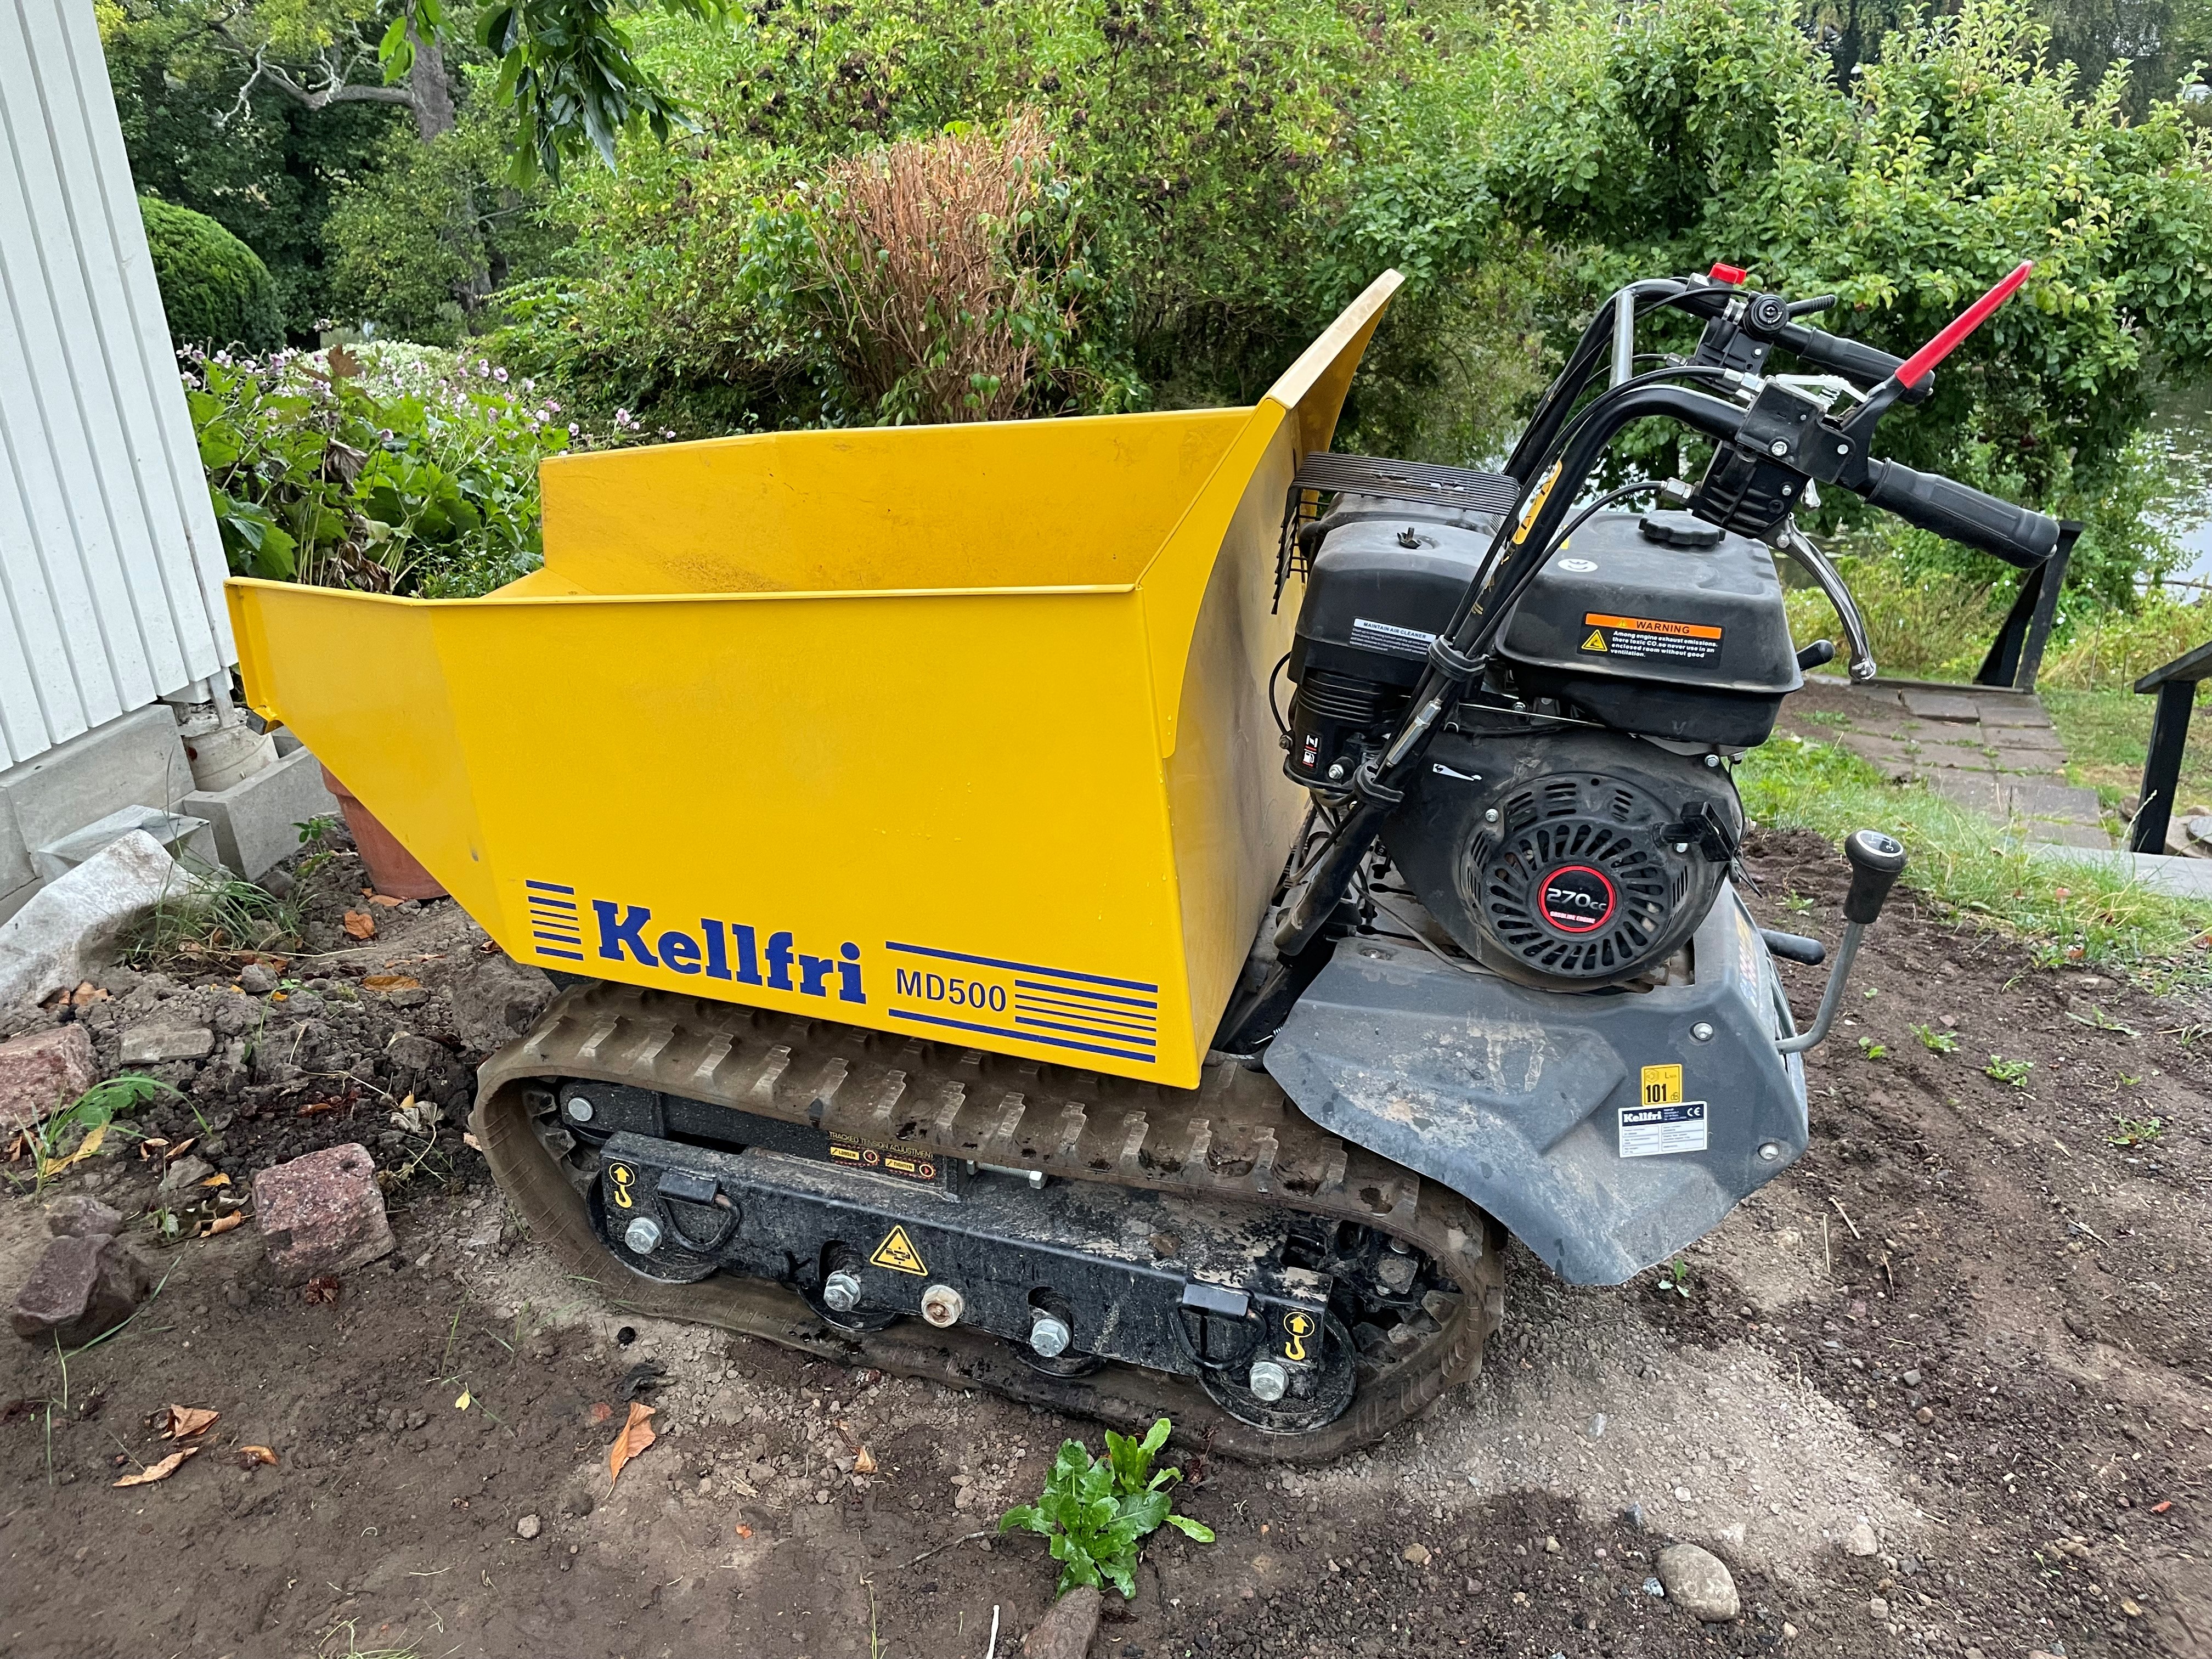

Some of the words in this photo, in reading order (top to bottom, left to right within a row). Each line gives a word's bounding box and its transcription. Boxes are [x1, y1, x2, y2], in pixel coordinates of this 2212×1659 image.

[1363, 622, 1389, 631] MAINTAIN
[1400, 630, 1426, 639] CLEANER
[1613, 630, 1636, 639] Among
[1636, 620, 1690, 634] WARNING
[1610, 649, 1646, 657] ventilation.
[1547, 888, 1607, 911] 270cc
[592, 900, 867, 1005] Kellfri
[896, 968, 1007, 1012] MD500
[1646, 1084, 1667, 1103] 101
[1623, 1111, 1662, 1123] Kellfri
[1687, 1107, 1701, 1117] CE
[829, 1131, 859, 1143] TRACKED
[861, 1138, 889, 1149] TENSION
[889, 1144, 934, 1159] ADJUSTMENT
[894, 1161, 913, 1170] TIGHTEN
